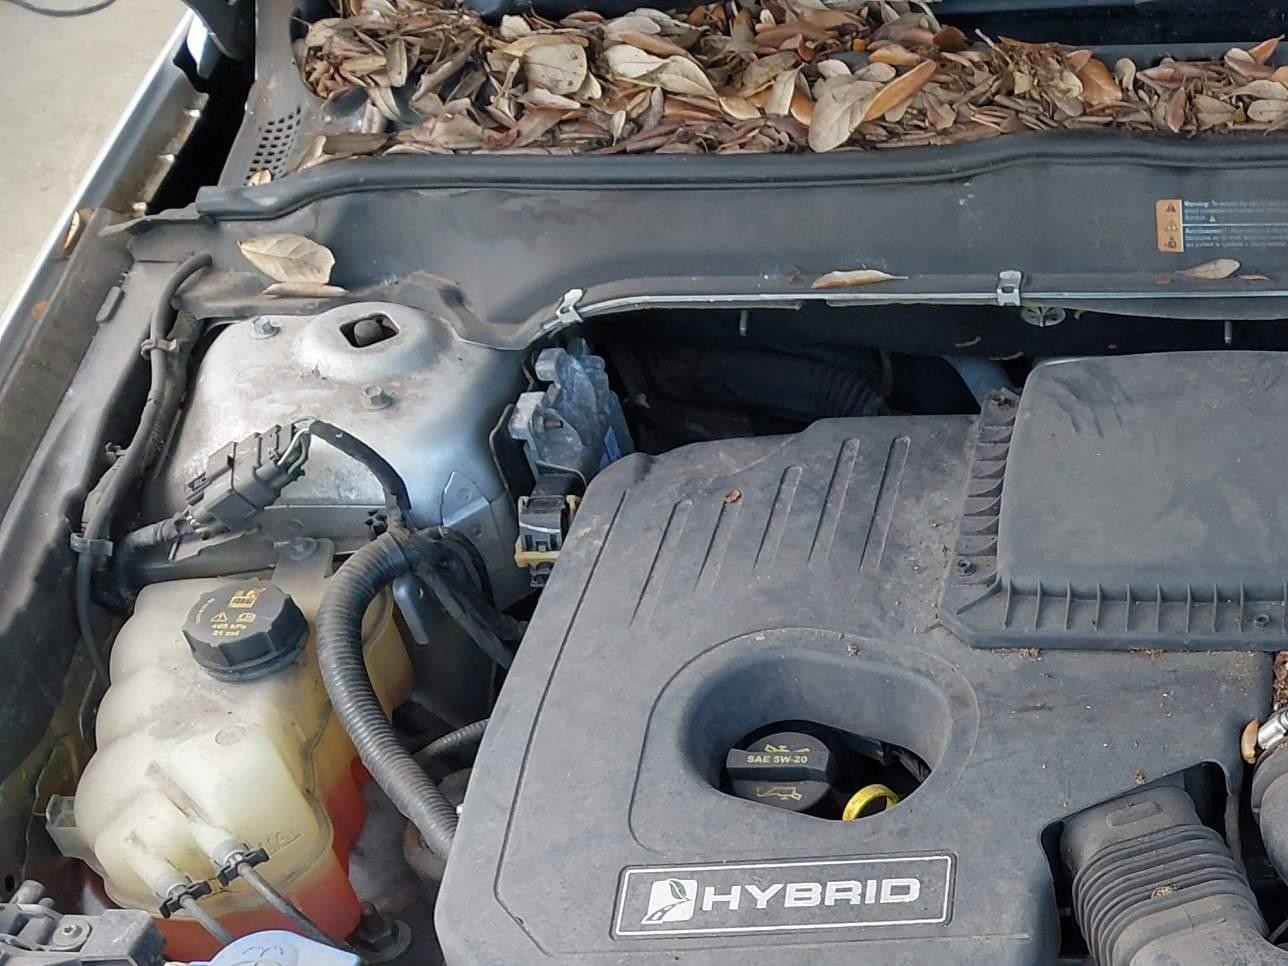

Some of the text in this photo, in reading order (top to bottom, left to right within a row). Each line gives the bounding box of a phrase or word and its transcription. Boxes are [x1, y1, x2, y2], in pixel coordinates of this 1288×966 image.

[746, 754, 808, 764] SAE 5W-20
[702, 877, 921, 911] HYBRID
